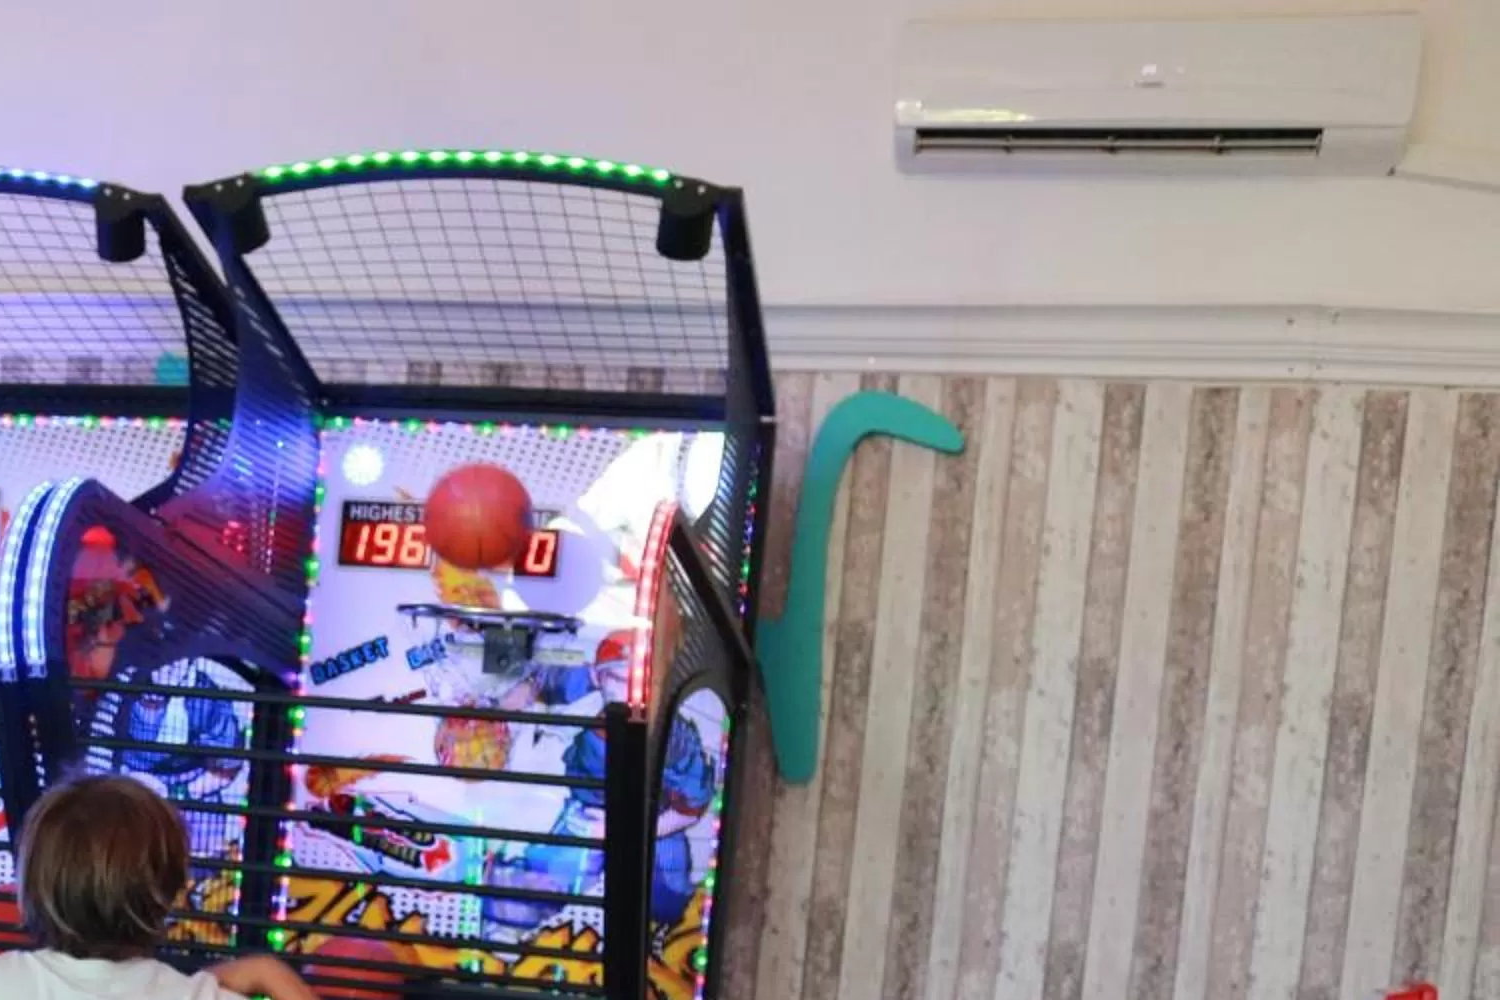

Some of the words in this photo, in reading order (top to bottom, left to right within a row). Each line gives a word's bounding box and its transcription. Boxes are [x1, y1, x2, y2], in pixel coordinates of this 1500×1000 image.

[350, 503, 425, 523] HIGHEST
[356, 524, 426, 566] 196
[310, 635, 389, 686] BASKET
